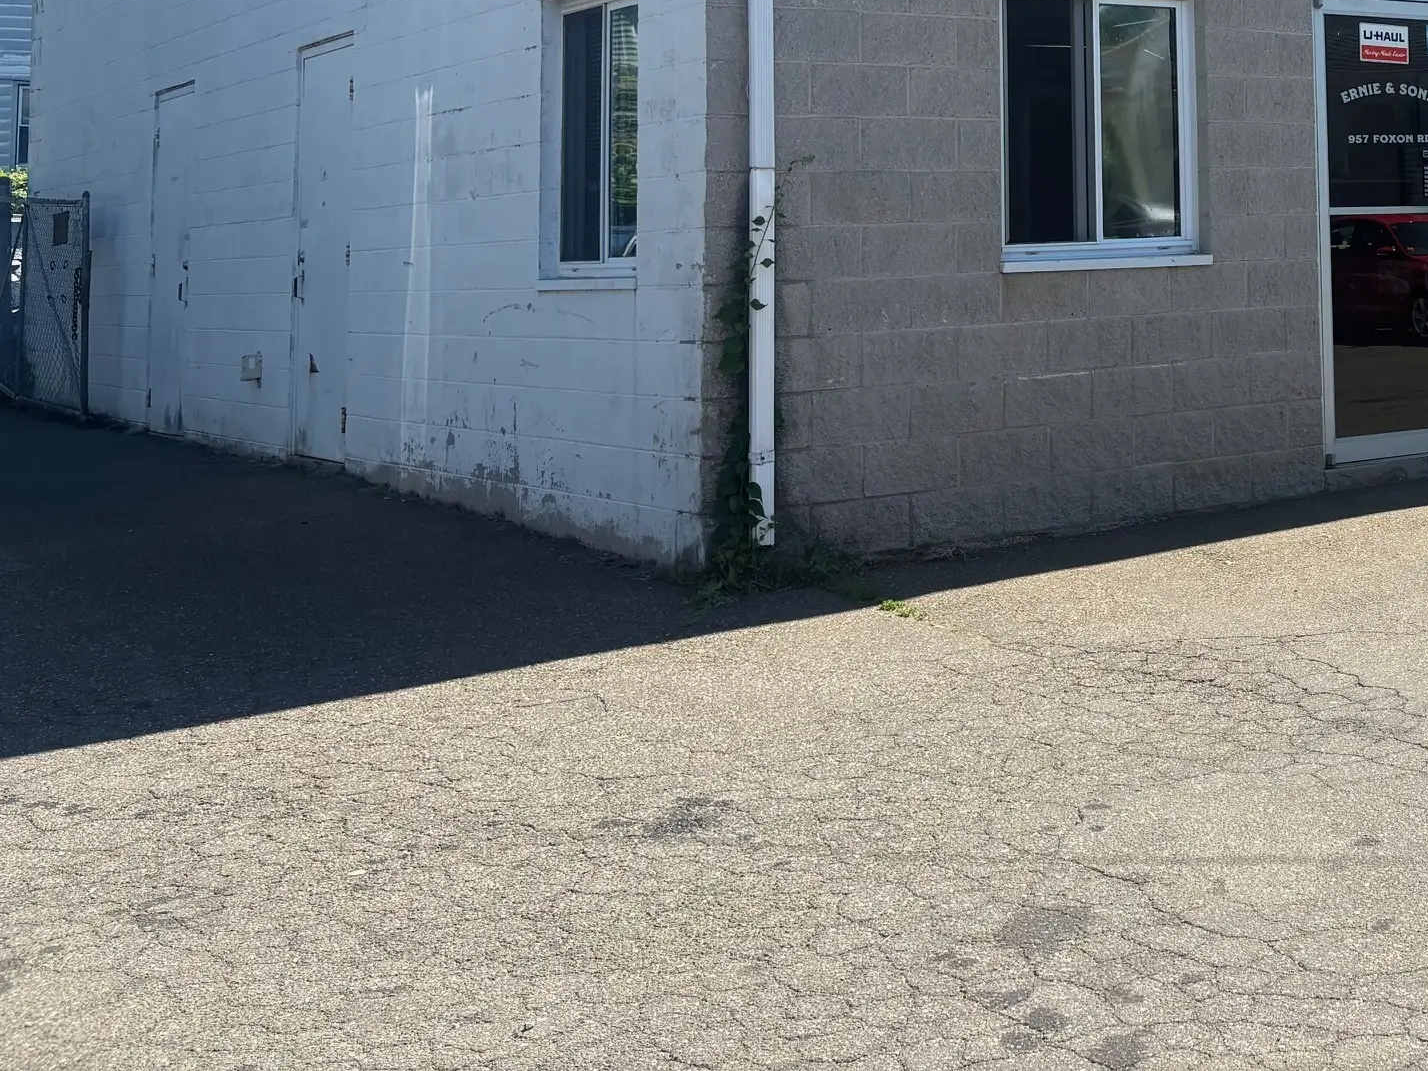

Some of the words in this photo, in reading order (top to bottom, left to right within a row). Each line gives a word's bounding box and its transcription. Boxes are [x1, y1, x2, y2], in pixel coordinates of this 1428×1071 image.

[1363, 30, 1405, 42] U-HAUL
[1340, 82, 1382, 104] ERNIE
[1385, 82, 1396, 94] &
[1348, 134, 1369, 144] 957
[1372, 134, 1414, 144] FOXON
